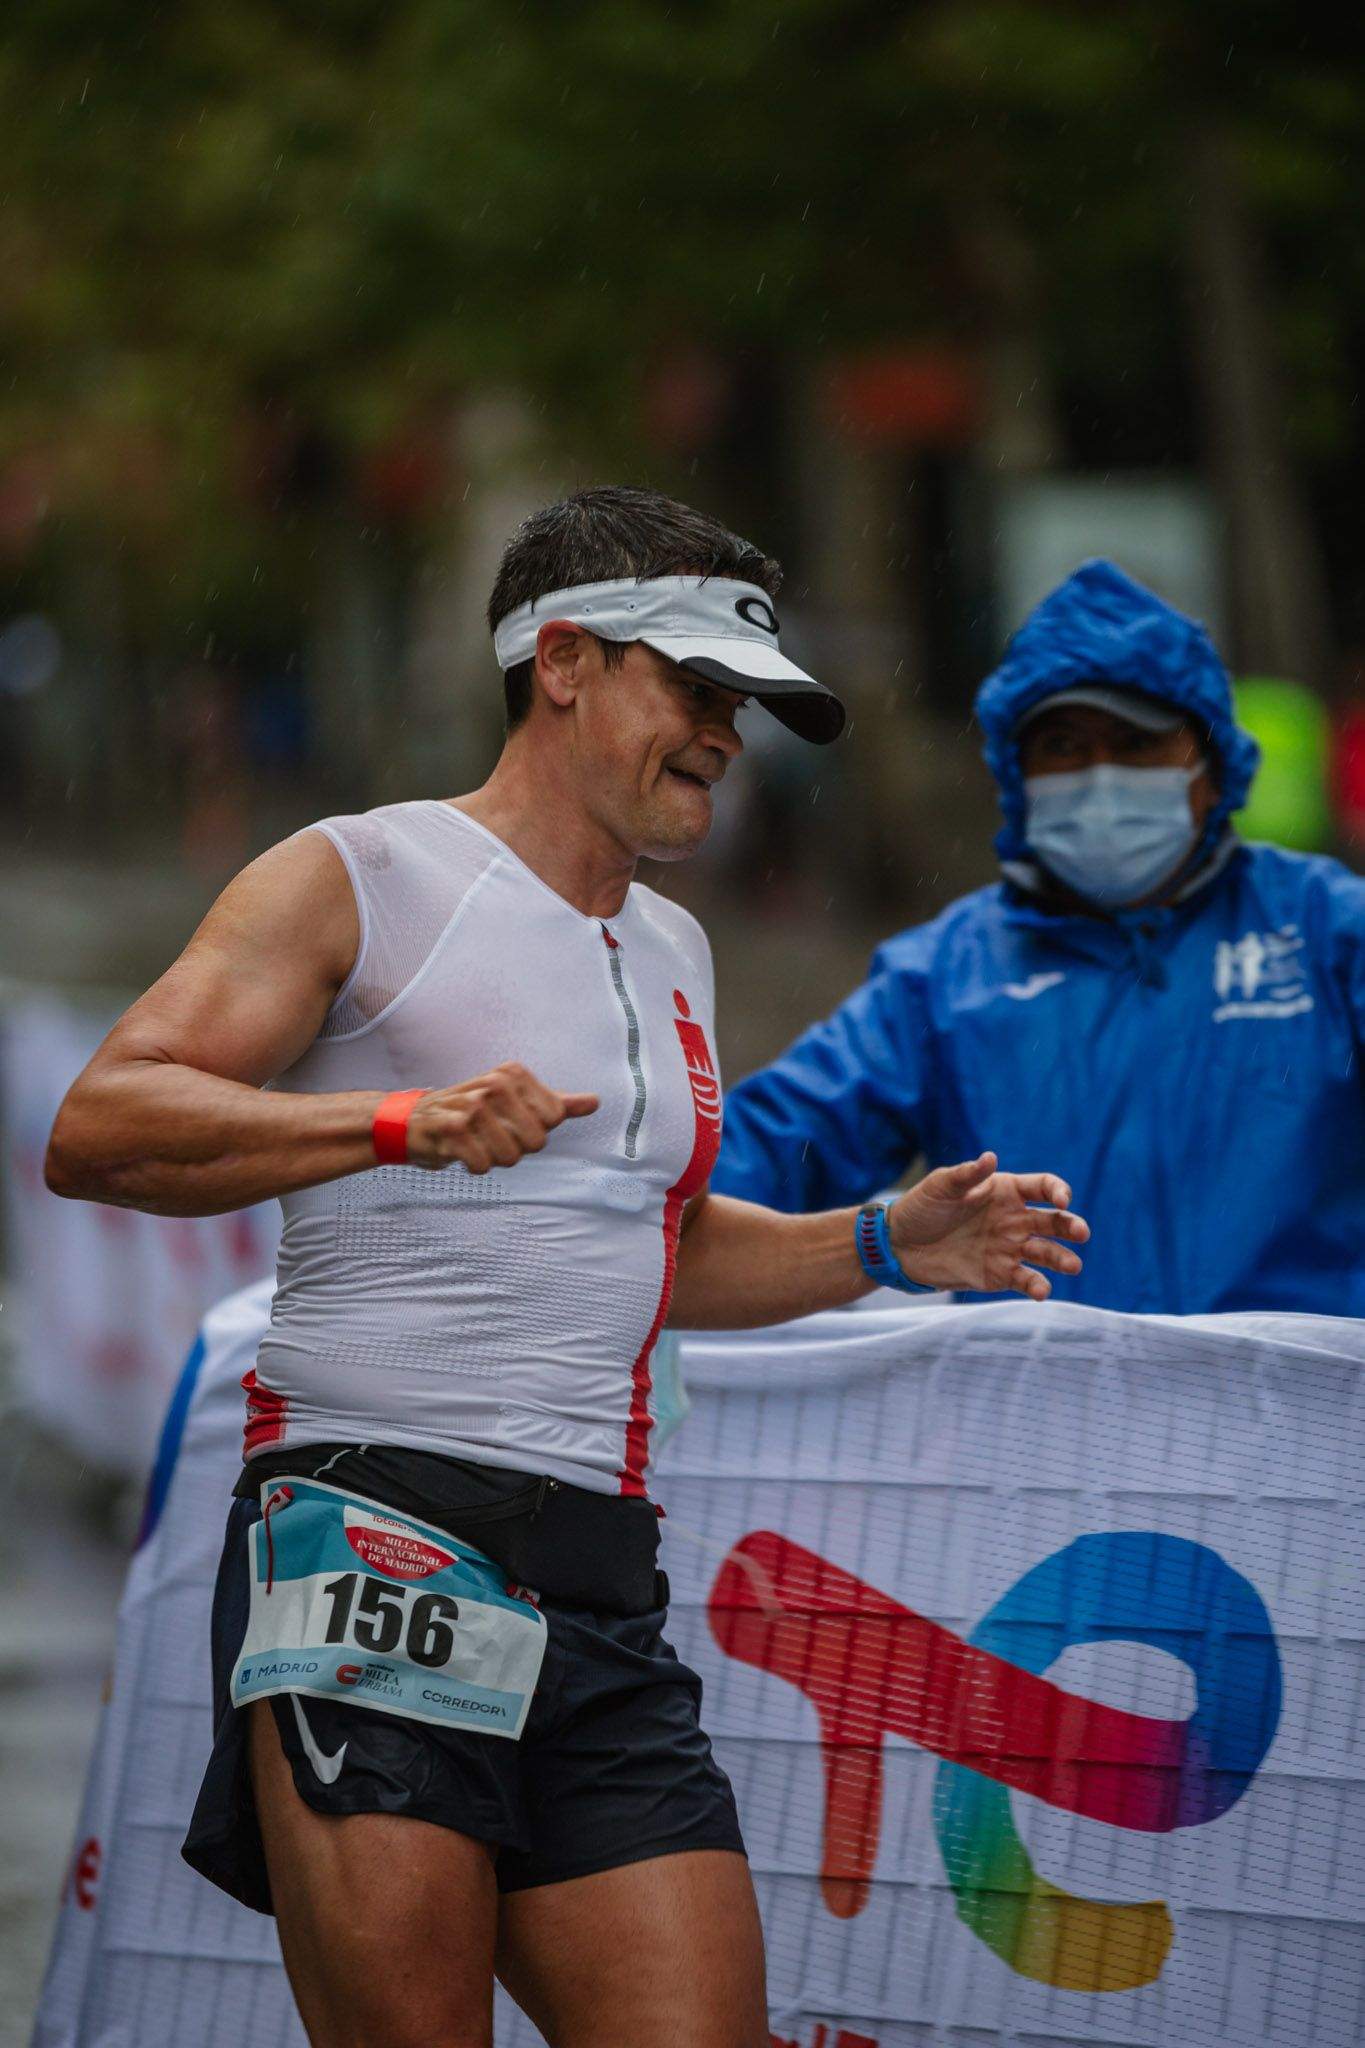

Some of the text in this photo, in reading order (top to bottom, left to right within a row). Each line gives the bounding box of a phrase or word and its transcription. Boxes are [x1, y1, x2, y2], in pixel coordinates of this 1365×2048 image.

[384, 1535, 419, 1552] MILLA
[367, 1552, 428, 1574] DE MADRID
[323, 1573, 459, 1668] 156
[257, 1662, 319, 1679] MADRID
[364, 1668, 399, 1686] MILLA
[357, 1677, 403, 1697] URBANA
